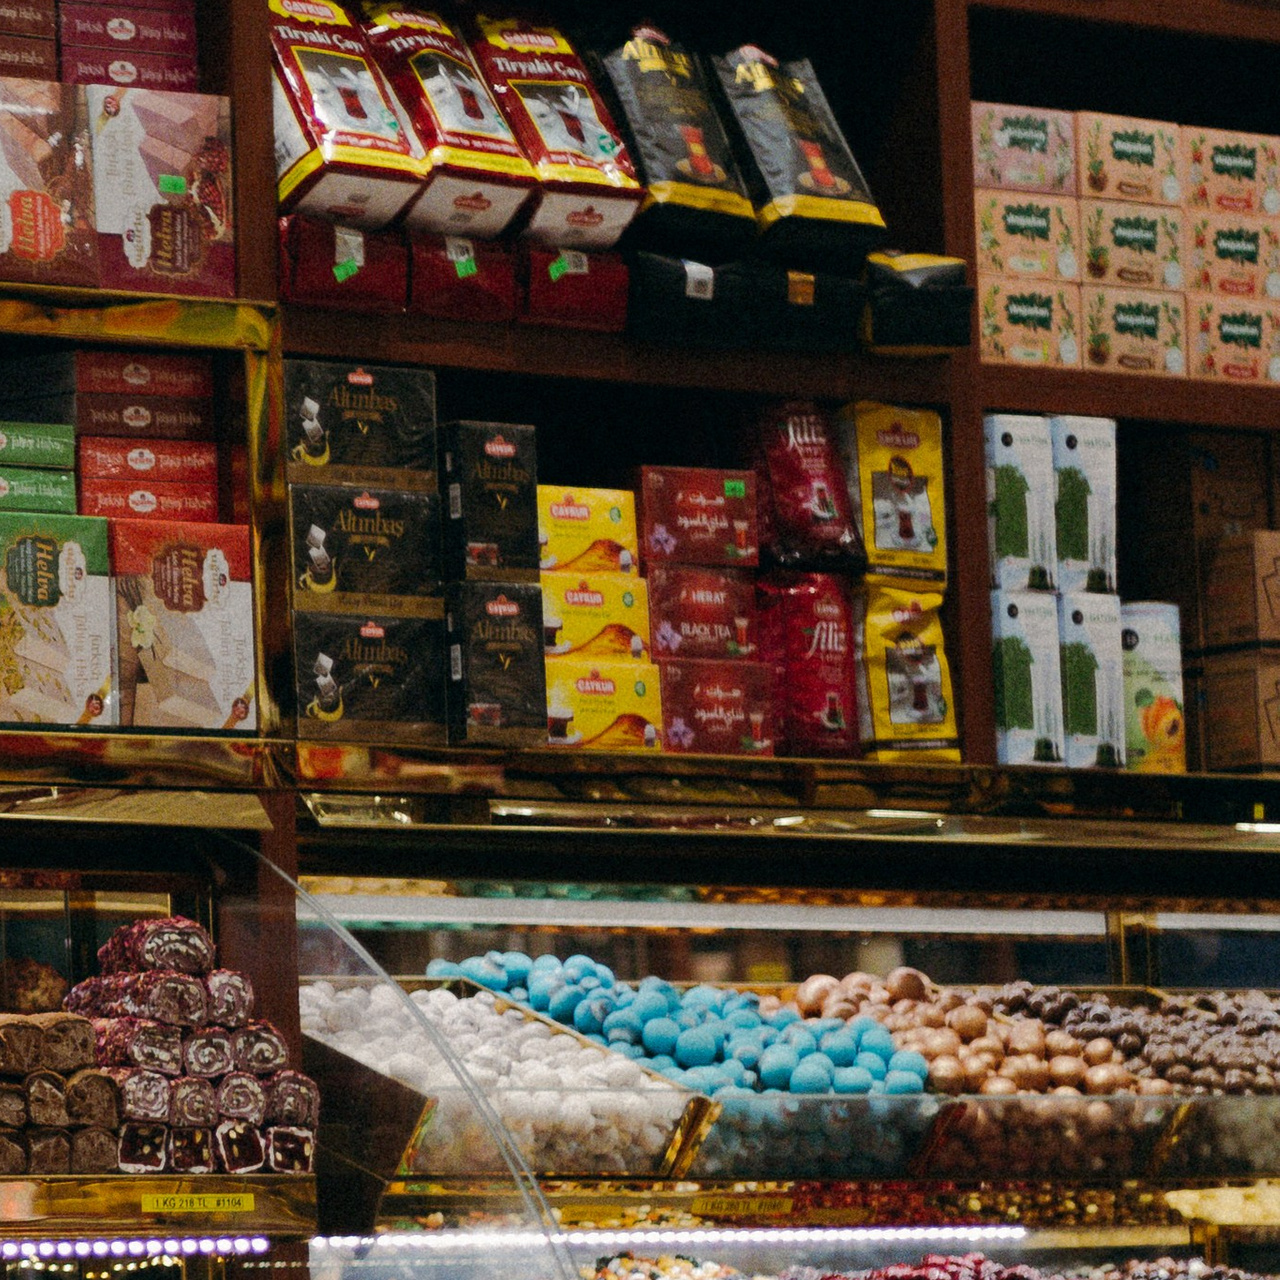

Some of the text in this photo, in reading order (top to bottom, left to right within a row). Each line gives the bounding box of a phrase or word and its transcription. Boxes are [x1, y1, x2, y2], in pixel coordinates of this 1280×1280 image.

[275, 26, 329, 44] Tiryaki
[493, 57, 551, 74] Tiryaki
[37, 538, 55, 601] Helva
[181, 550, 198, 606] Helva
[692, 591, 726, 604] HERAT
[681, 623, 730, 637] BLACK TEA
[163, 1198, 176, 1208] KG
[179, 1198, 195, 1208] 218
[198, 1198, 208, 1208] TL
